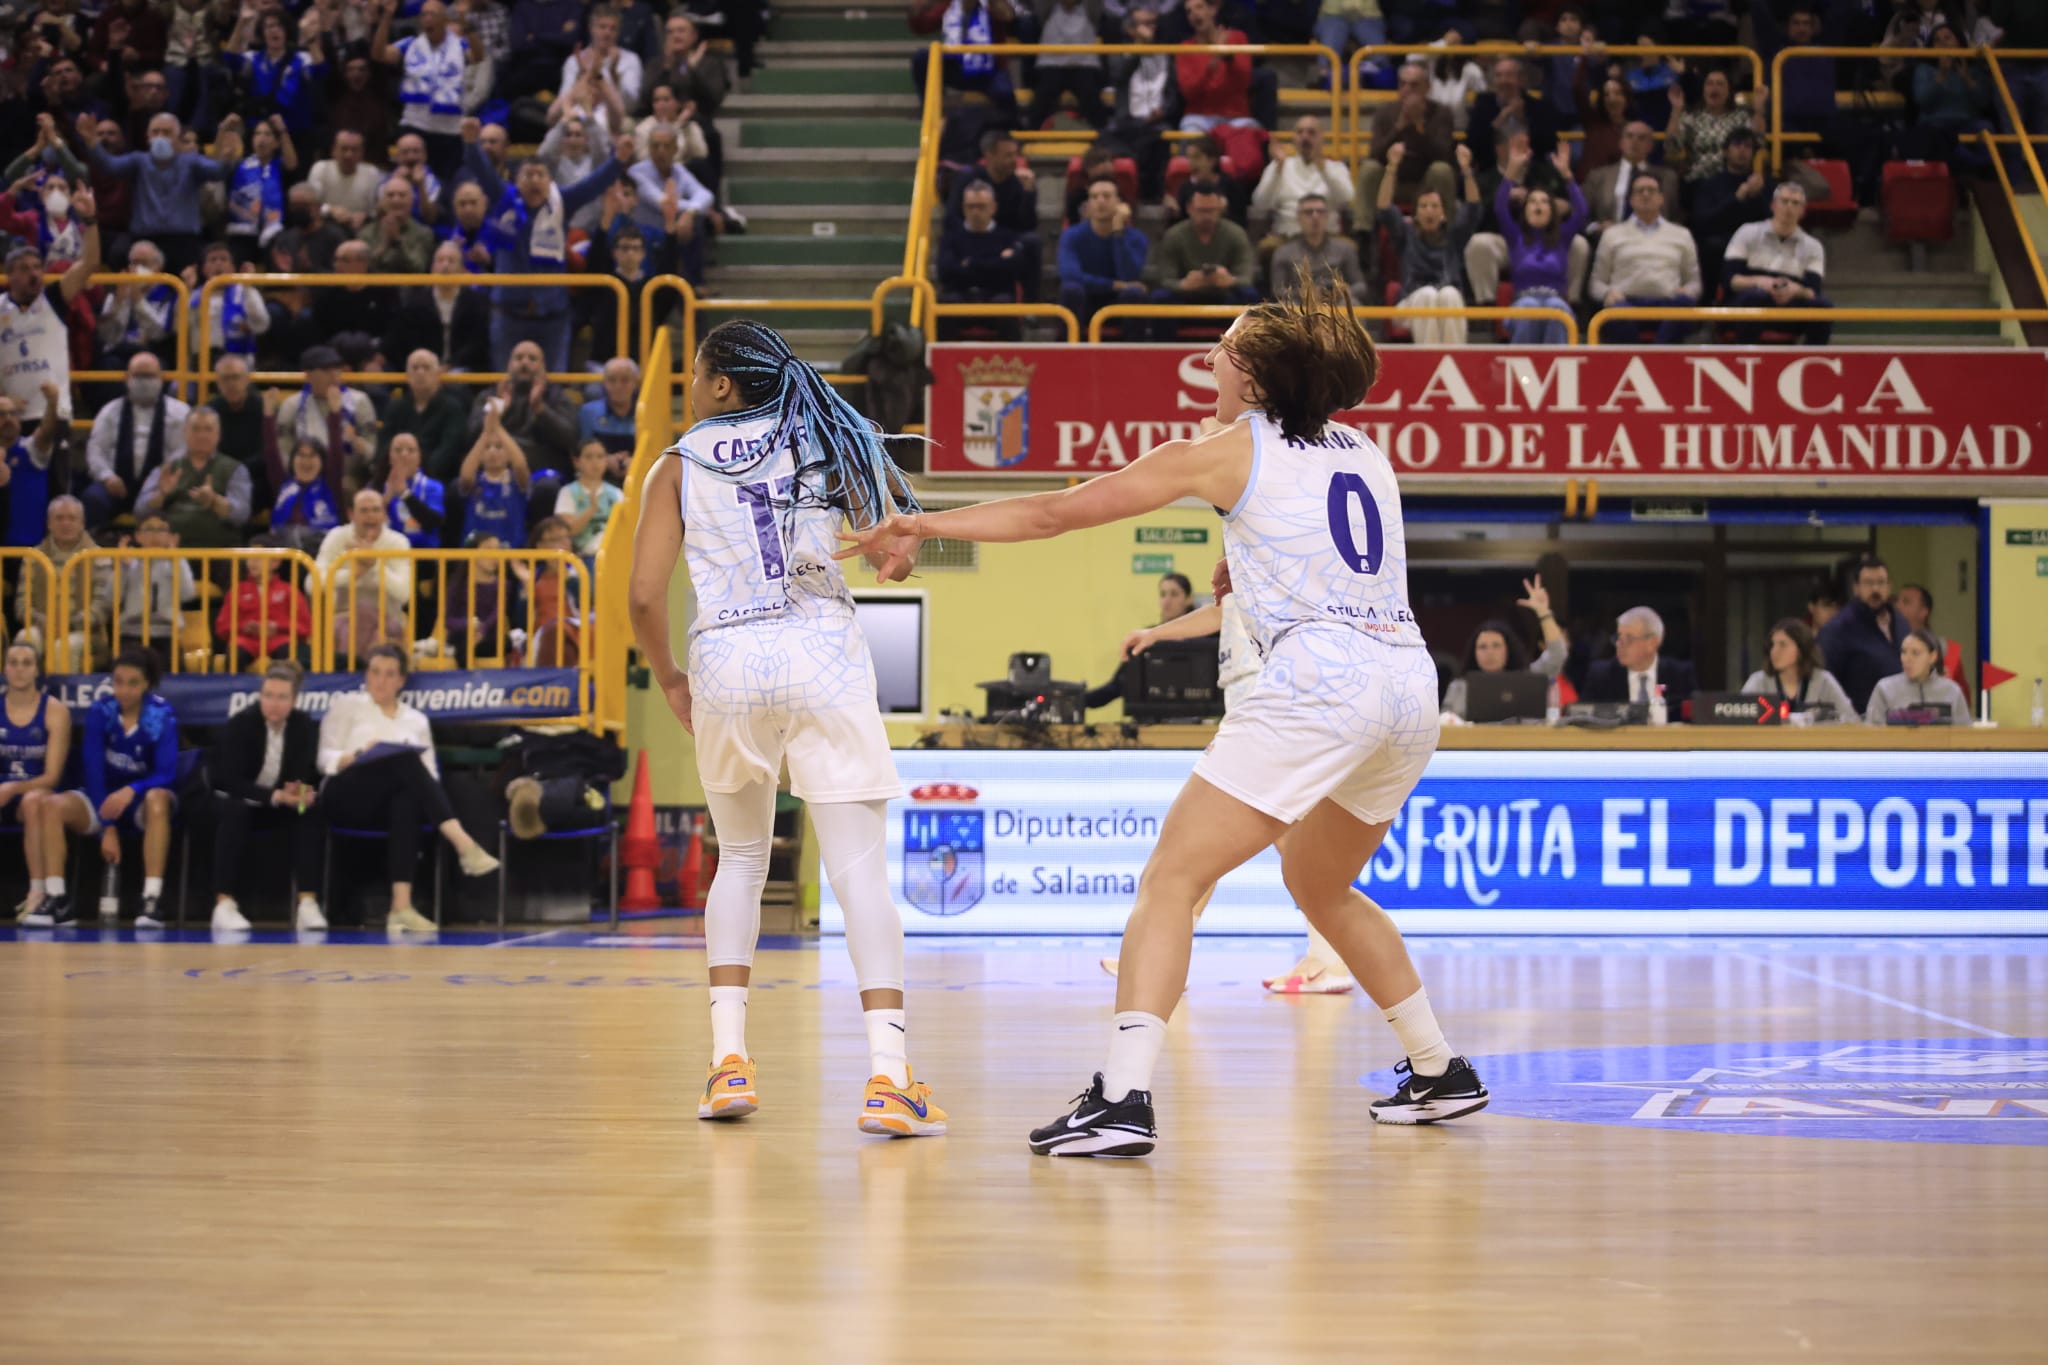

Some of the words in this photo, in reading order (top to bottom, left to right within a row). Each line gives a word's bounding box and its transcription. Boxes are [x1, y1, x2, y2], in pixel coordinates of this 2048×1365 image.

[1177, 353, 1933, 413] SAMANCA
[1461, 422, 1545, 469] DE
[1566, 422, 1641, 469] LA
[1660, 422, 2032, 471] HUMANIDAD
[1327, 471, 1384, 575] 0
[994, 808, 1157, 845] Diputación
[1359, 795, 1577, 906] SFRUTA
[1602, 798, 1692, 887] EL
[992, 873, 1017, 894] de
[1031, 866, 1135, 895] Salama
